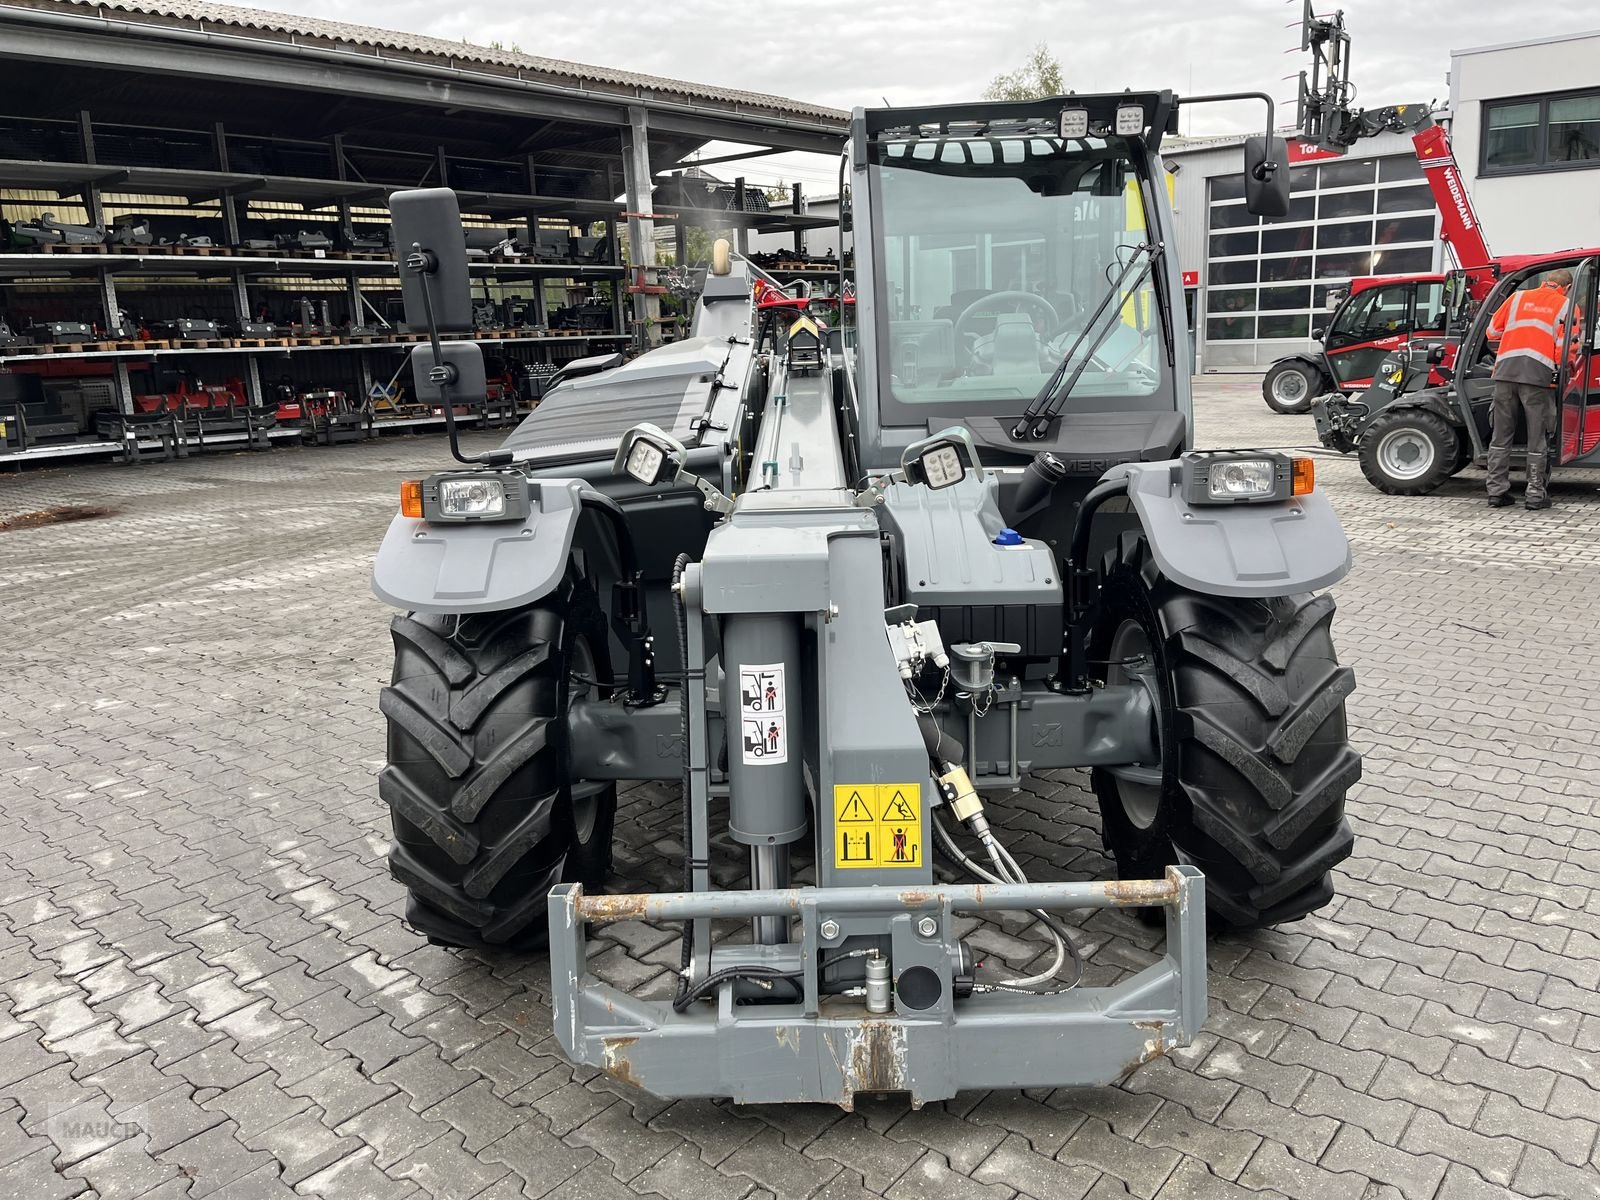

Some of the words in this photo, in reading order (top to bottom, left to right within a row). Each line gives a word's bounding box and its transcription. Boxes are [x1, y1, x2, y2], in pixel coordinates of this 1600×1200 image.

[1299, 143, 1318, 154] Tor
[1443, 167, 1473, 230] WEIDEMANN
[1064, 457, 1131, 473] MERL
